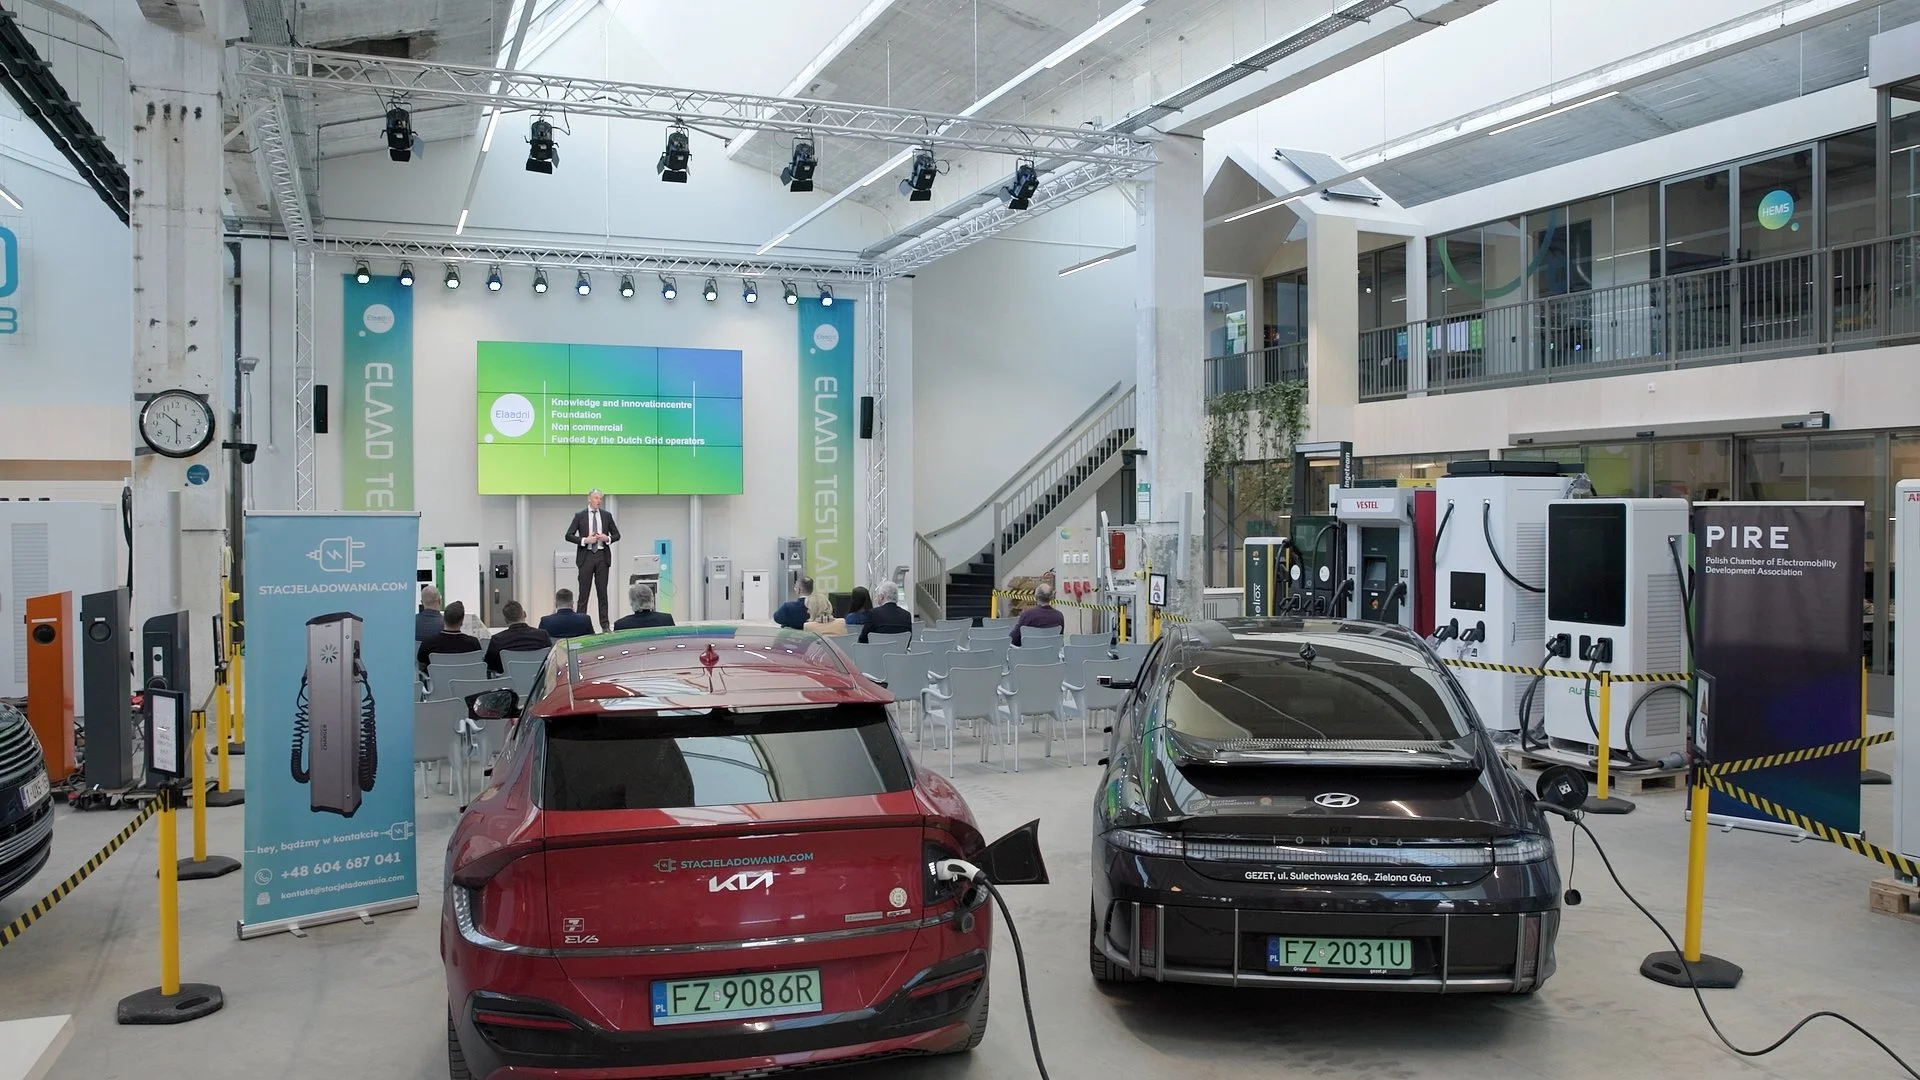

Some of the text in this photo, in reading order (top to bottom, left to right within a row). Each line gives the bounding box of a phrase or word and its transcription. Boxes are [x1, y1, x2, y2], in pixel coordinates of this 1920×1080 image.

[1763, 203, 1790, 217] HEMS
[551, 398, 600, 408] Knowledge
[604, 399, 619, 408] and
[551, 411, 602, 420] Foundation
[572, 424, 623, 432] commercial
[365, 362, 394, 511] ELAAD TE
[551, 434, 705, 447] Funded by the Dutch Grid operators
[814, 376, 838, 593] ELAAD TESTLAB
[1356, 501, 1379, 509] VESTEL
[1706, 526, 1789, 549] PIRE
[1705, 557, 1837, 569] Polish Chamber of Electromobility
[1705, 566, 1803, 576] Development Association
[259, 582, 408, 595] STACJELADOWANIA.COM
[257, 845, 278, 854] hey,
[333, 830, 380, 843] kontakcie
[281, 851, 401, 879] +48 604 687 041
[680, 852, 814, 869] STACJELADOWANIA.COM
[708, 871, 774, 893] KIA
[1244, 872, 1432, 882] GEZET, ul. Sulechowska 26a, Zielona Góra
[281, 874, 405, 899] kontakt@stacjeladowania.com
[565, 935, 599, 943] EV6
[1285, 940, 1317, 964] FZ
[1327, 941, 1405, 966] 2031U
[655, 974, 813, 1013] PL FZ 9086R
